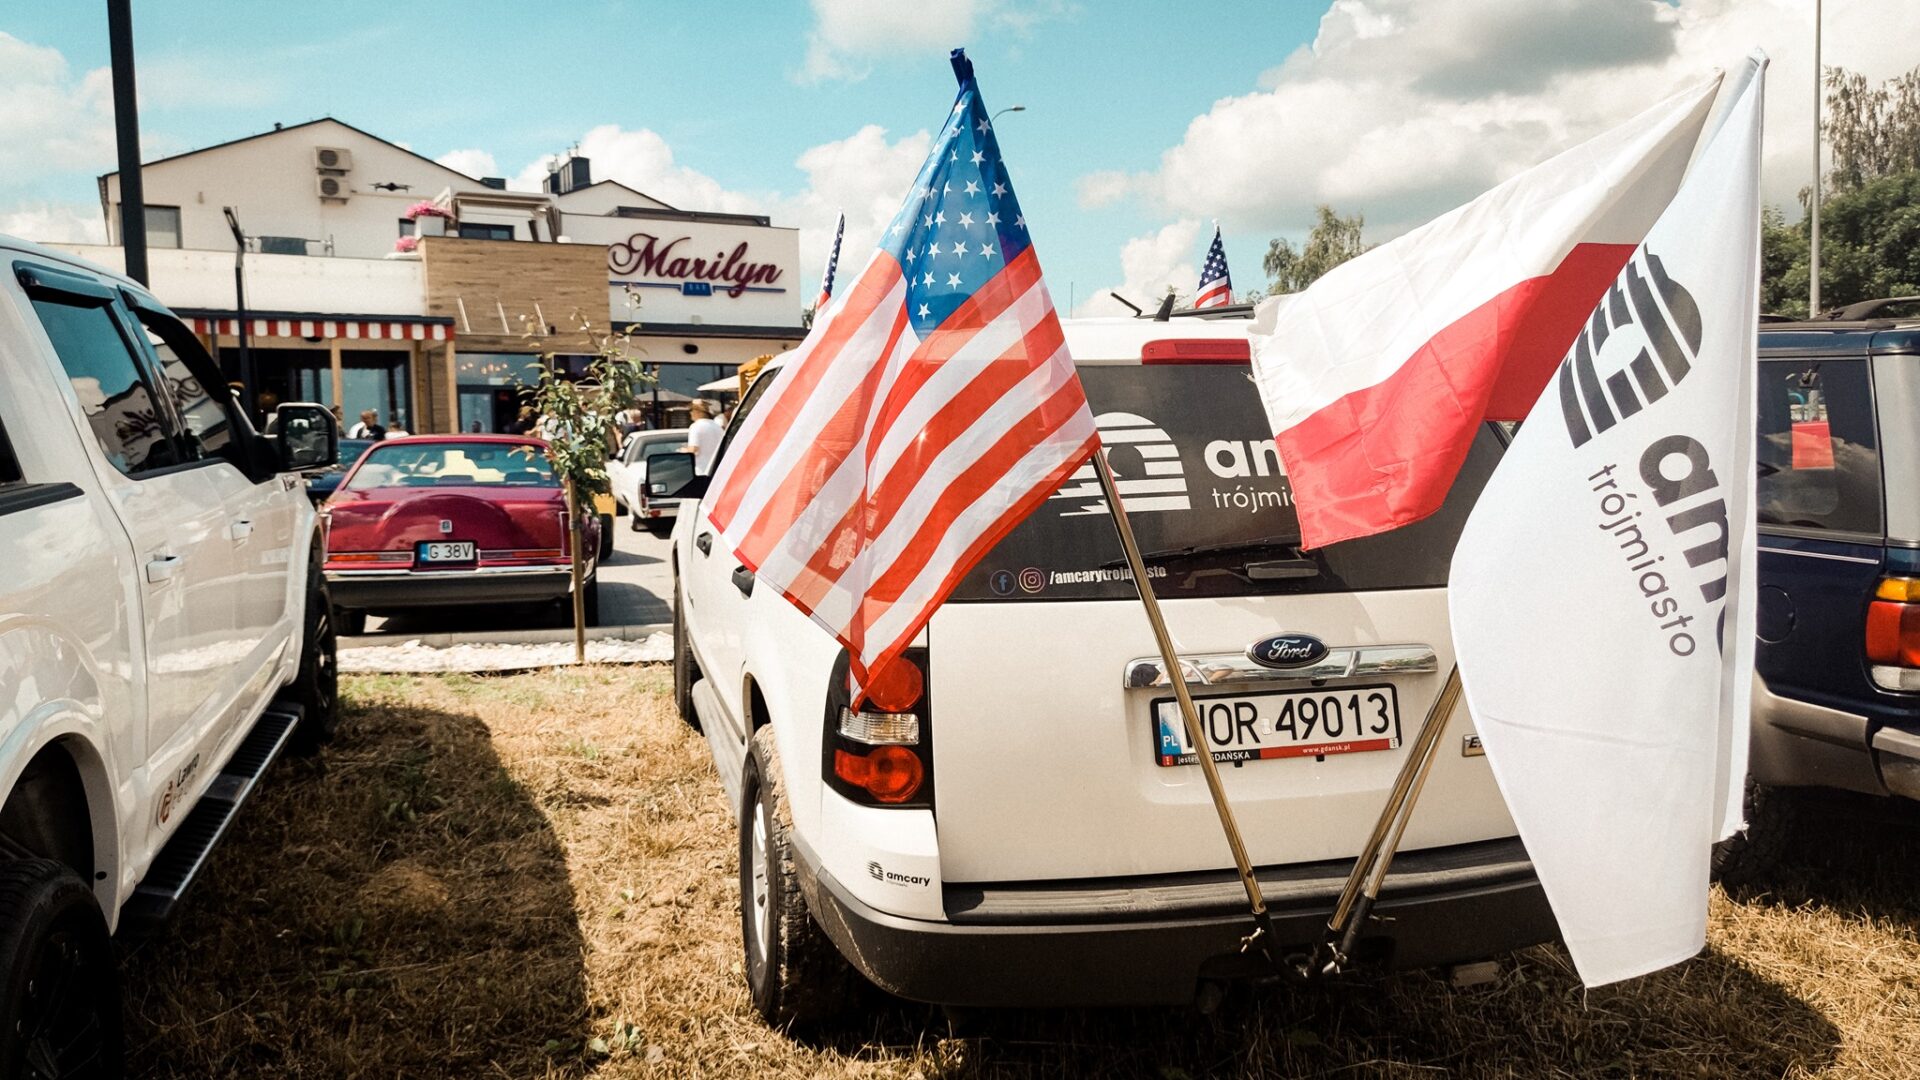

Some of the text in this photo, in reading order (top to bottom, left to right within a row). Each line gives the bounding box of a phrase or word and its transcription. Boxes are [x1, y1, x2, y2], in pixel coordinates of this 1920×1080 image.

[608, 233, 783, 298] Marilyn
[430, 543, 471, 559] G 38V
[1588, 463, 1696, 657] trójmiasto
[1639, 434, 1729, 662] am
[1268, 639, 1312, 660] Ford
[1275, 693, 1390, 741] 49013
[1163, 736, 1178, 747] PL
[886, 871, 931, 887] amcary
